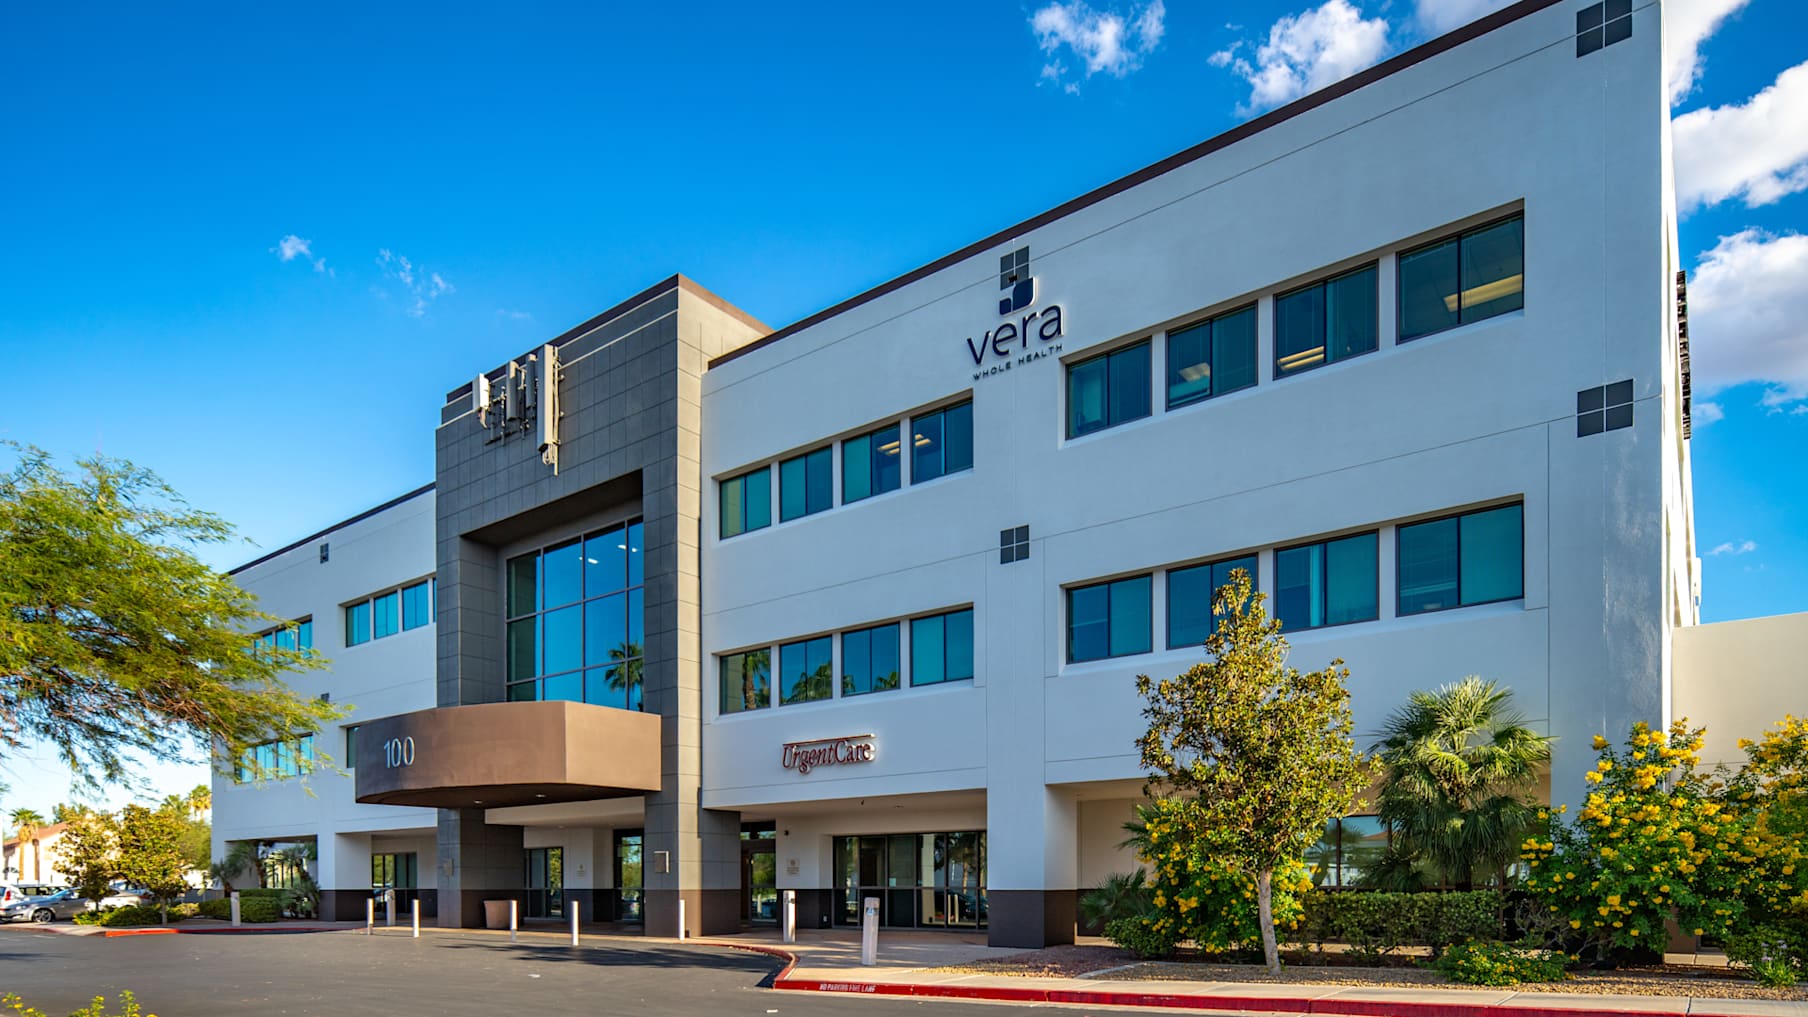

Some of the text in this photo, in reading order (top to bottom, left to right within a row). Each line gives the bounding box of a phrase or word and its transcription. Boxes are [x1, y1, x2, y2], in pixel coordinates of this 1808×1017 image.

[967, 305, 1063, 366] vera
[973, 345, 1063, 381] WHOLE HEALTH
[383, 736, 415, 769] 100
